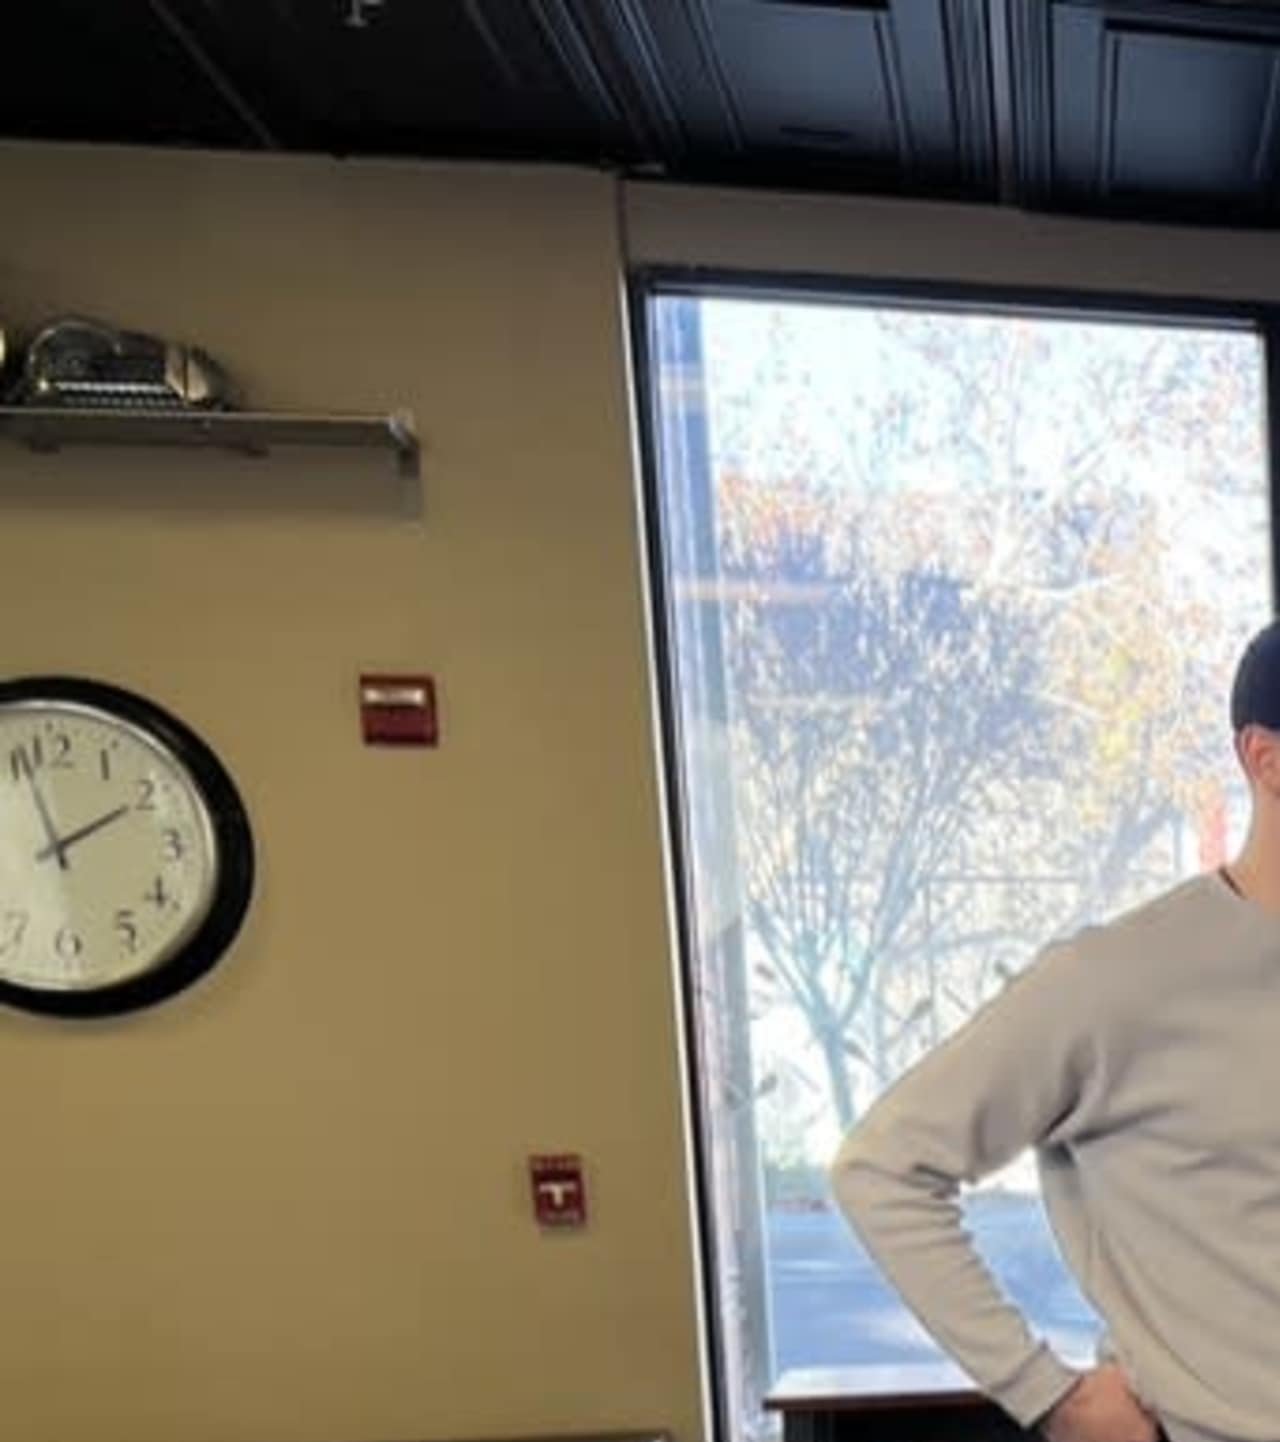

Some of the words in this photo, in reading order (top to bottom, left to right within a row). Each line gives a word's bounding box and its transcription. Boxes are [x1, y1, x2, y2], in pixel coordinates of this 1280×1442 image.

[134, 779, 155, 810] 2
[164, 828, 183, 860] 3
[144, 876, 168, 908] 4
[4, 911, 30, 944] 7
[55, 929, 82, 956] 6
[116, 909, 137, 953] 5
